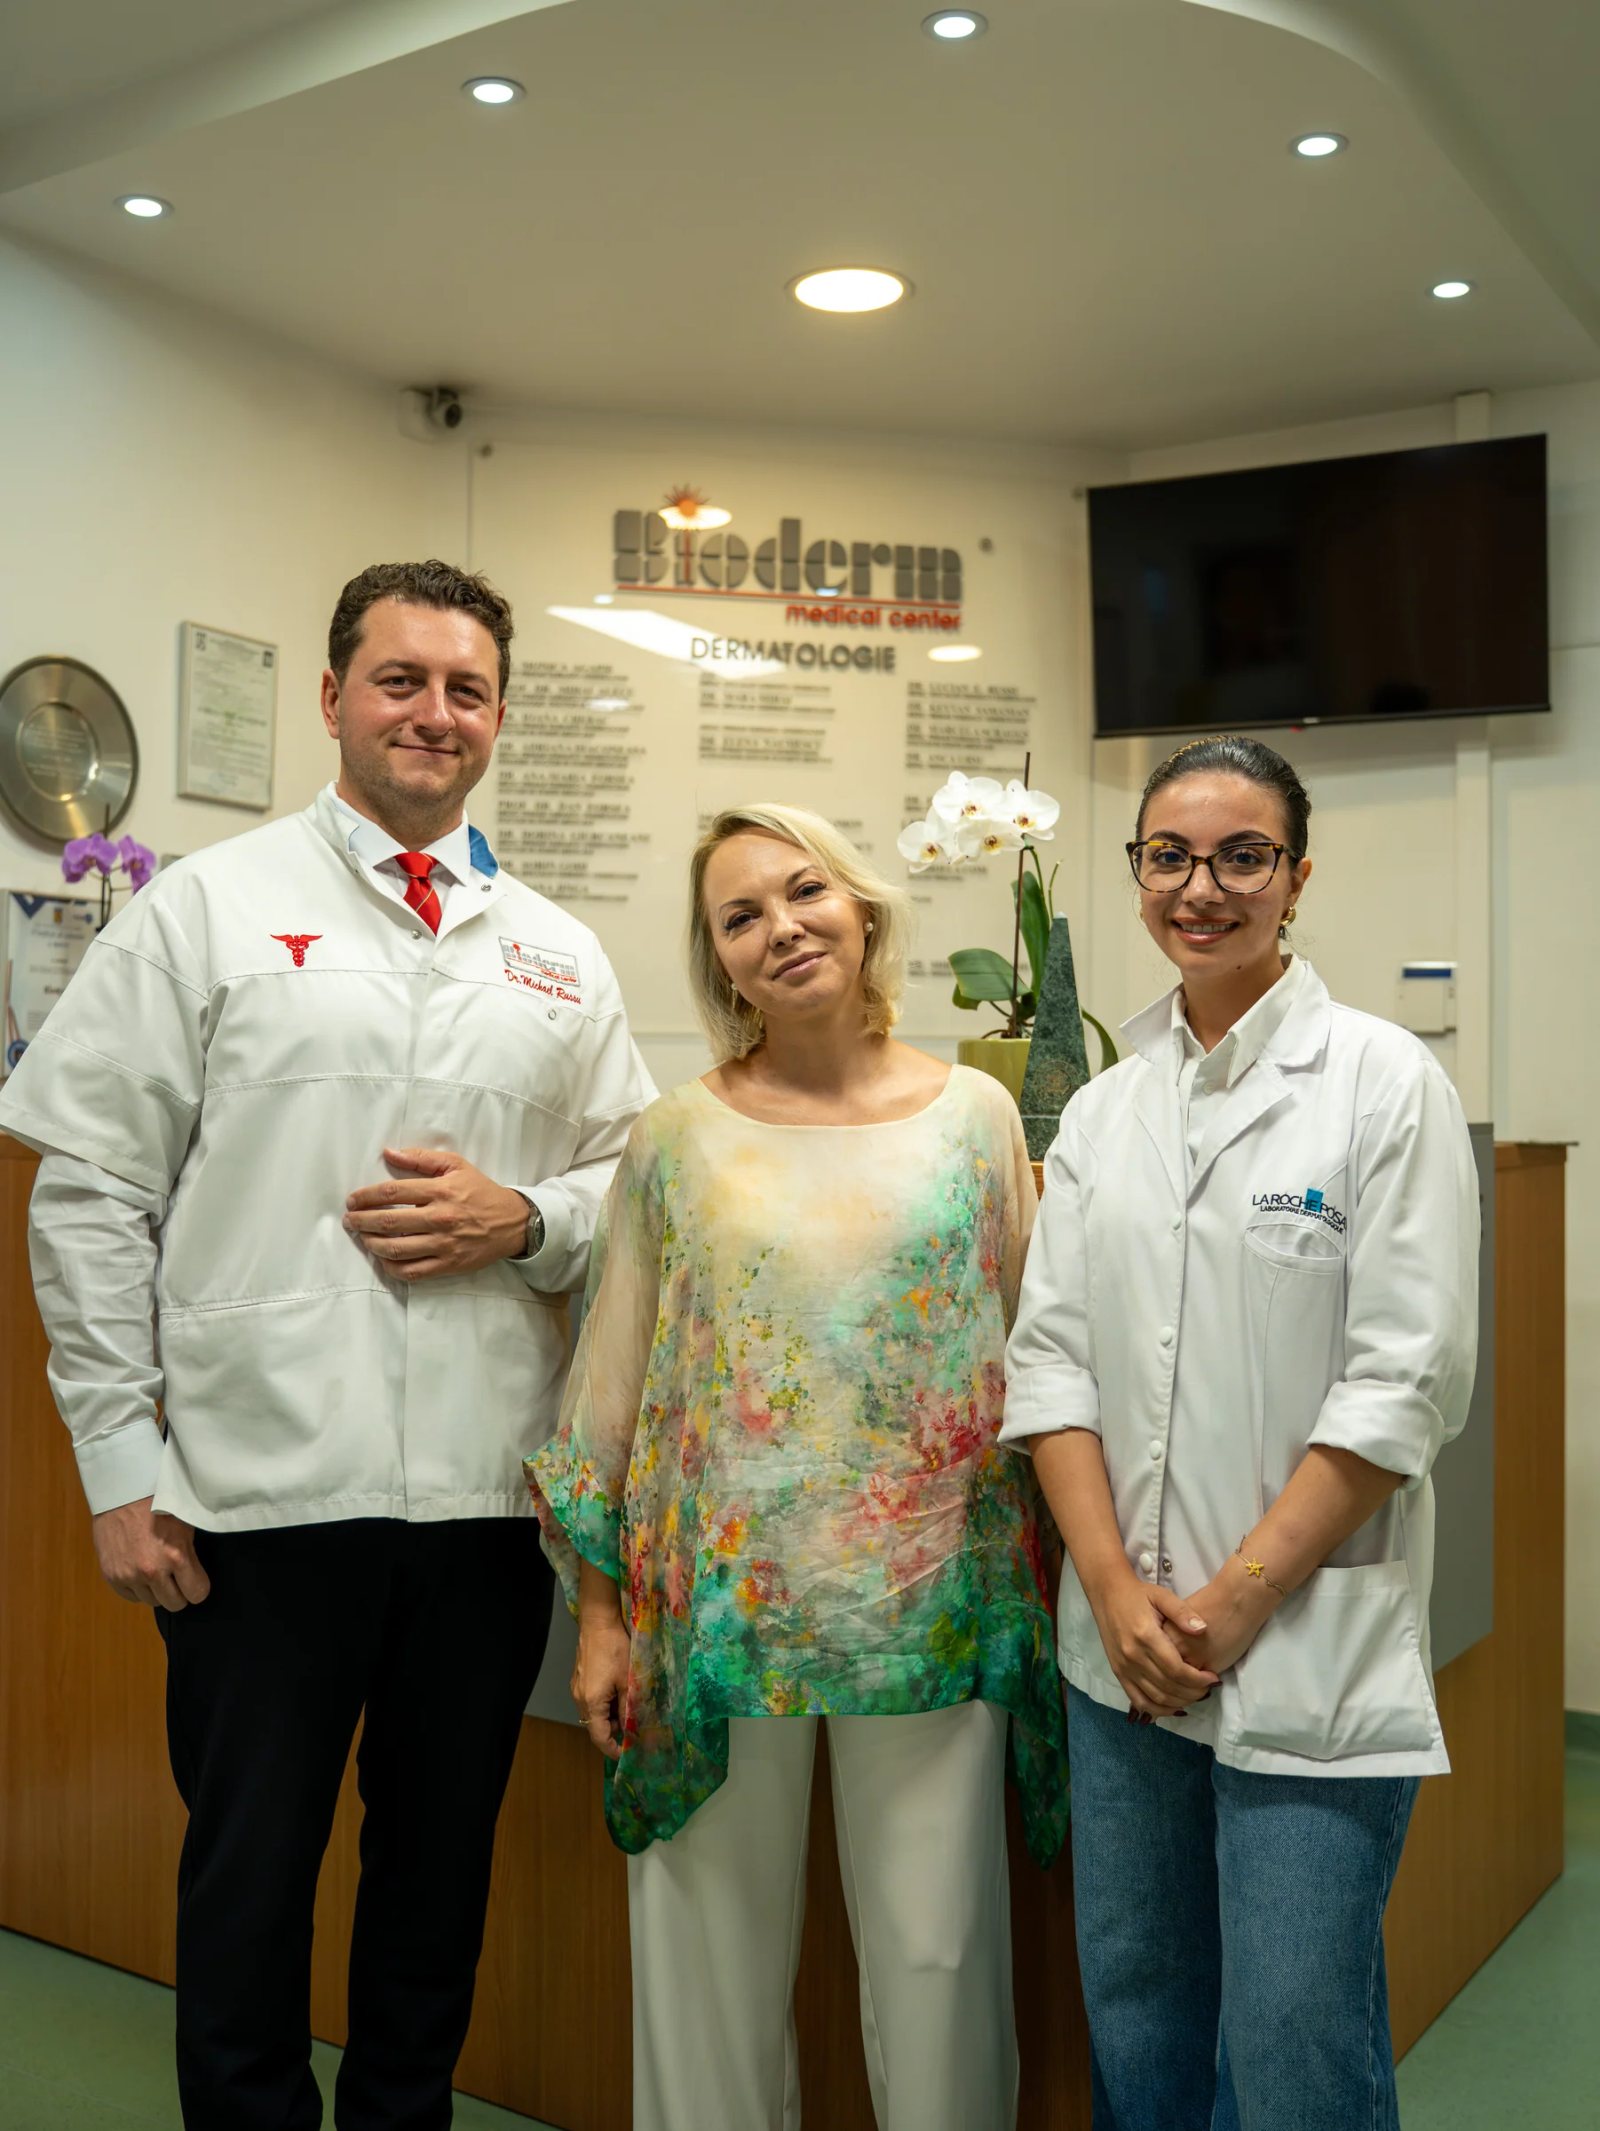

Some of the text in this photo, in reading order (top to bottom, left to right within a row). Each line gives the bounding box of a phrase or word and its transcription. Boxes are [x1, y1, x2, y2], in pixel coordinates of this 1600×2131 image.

[785, 603, 962, 631] medical center
[690, 637, 896, 673] DERMATOLOGIE
[504, 969, 521, 985] Dr.
[1270, 1193, 1319, 1213] ROCHE
[1319, 1202, 1348, 1232] POSA
